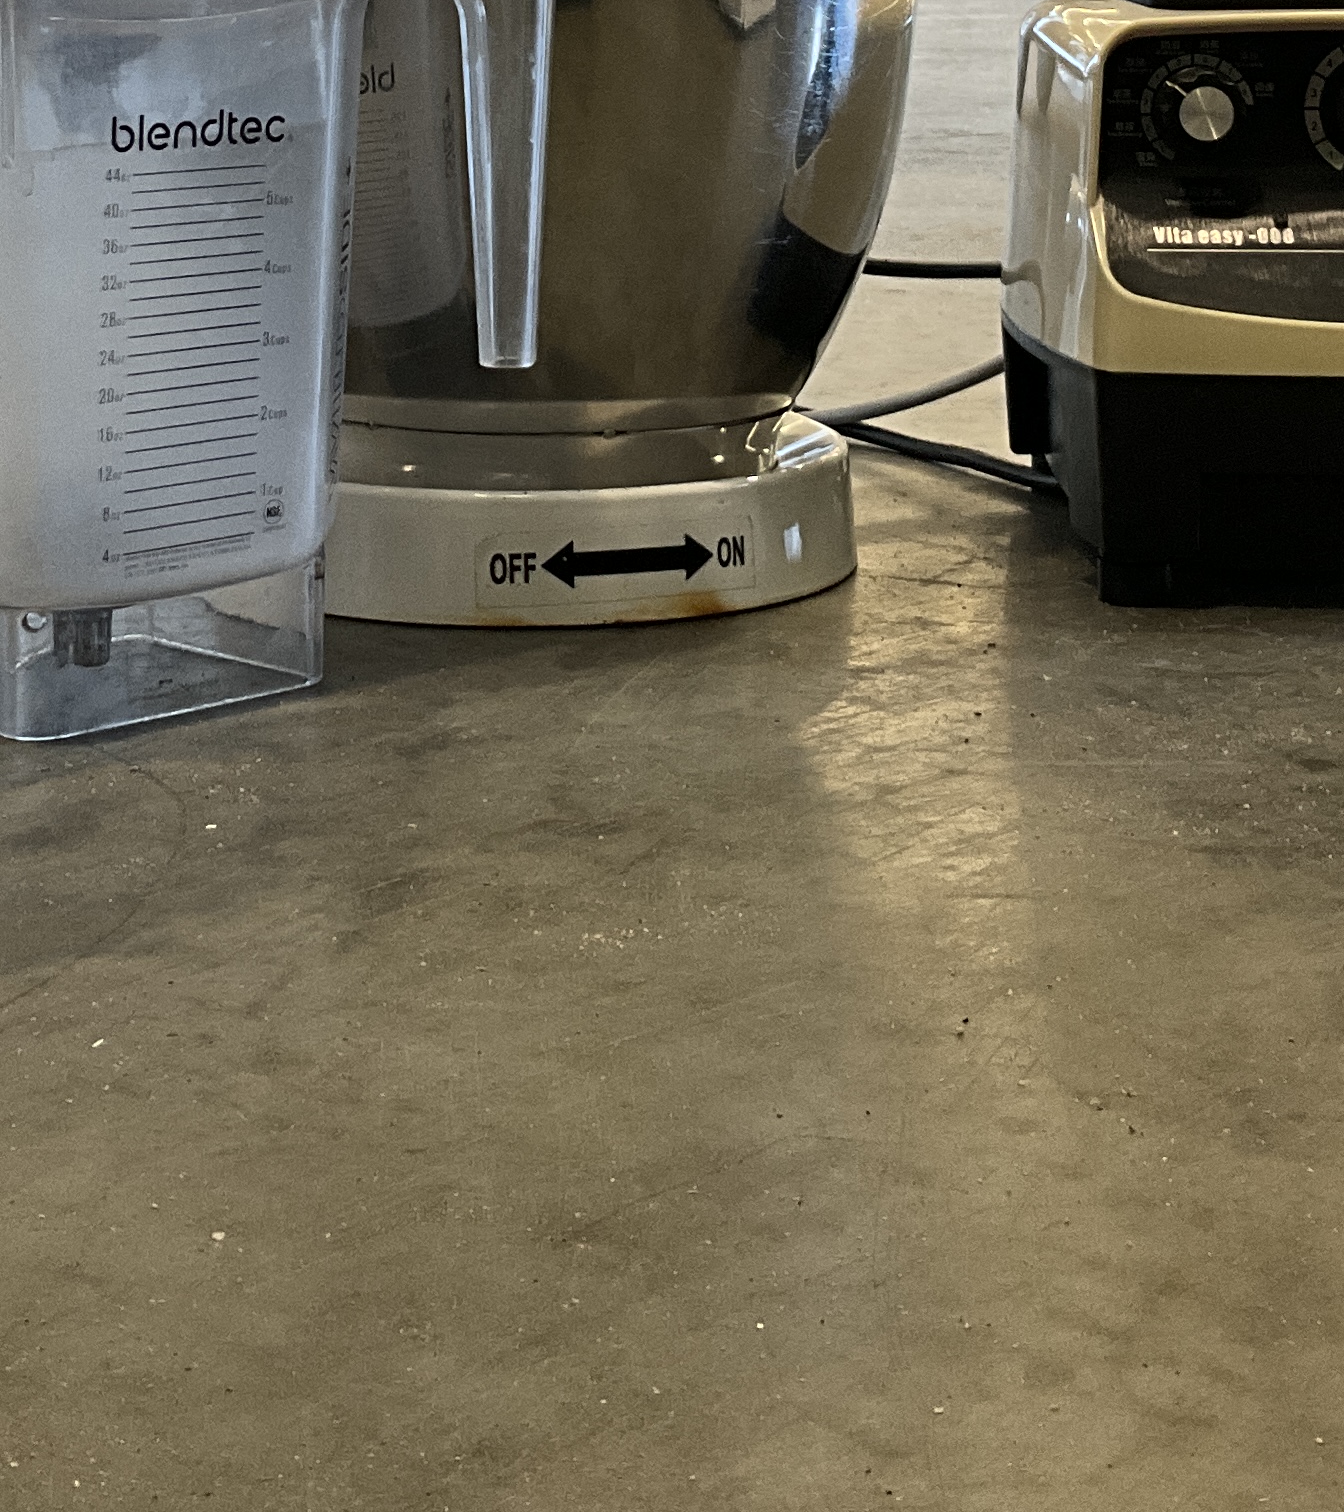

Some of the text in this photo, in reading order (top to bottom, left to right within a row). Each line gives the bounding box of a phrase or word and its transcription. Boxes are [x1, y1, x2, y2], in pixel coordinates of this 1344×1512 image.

[111, 109, 285, 153] blendtec
[1197, 229, 1244, 246] easy
[489, 536, 745, 584] OFF ON
